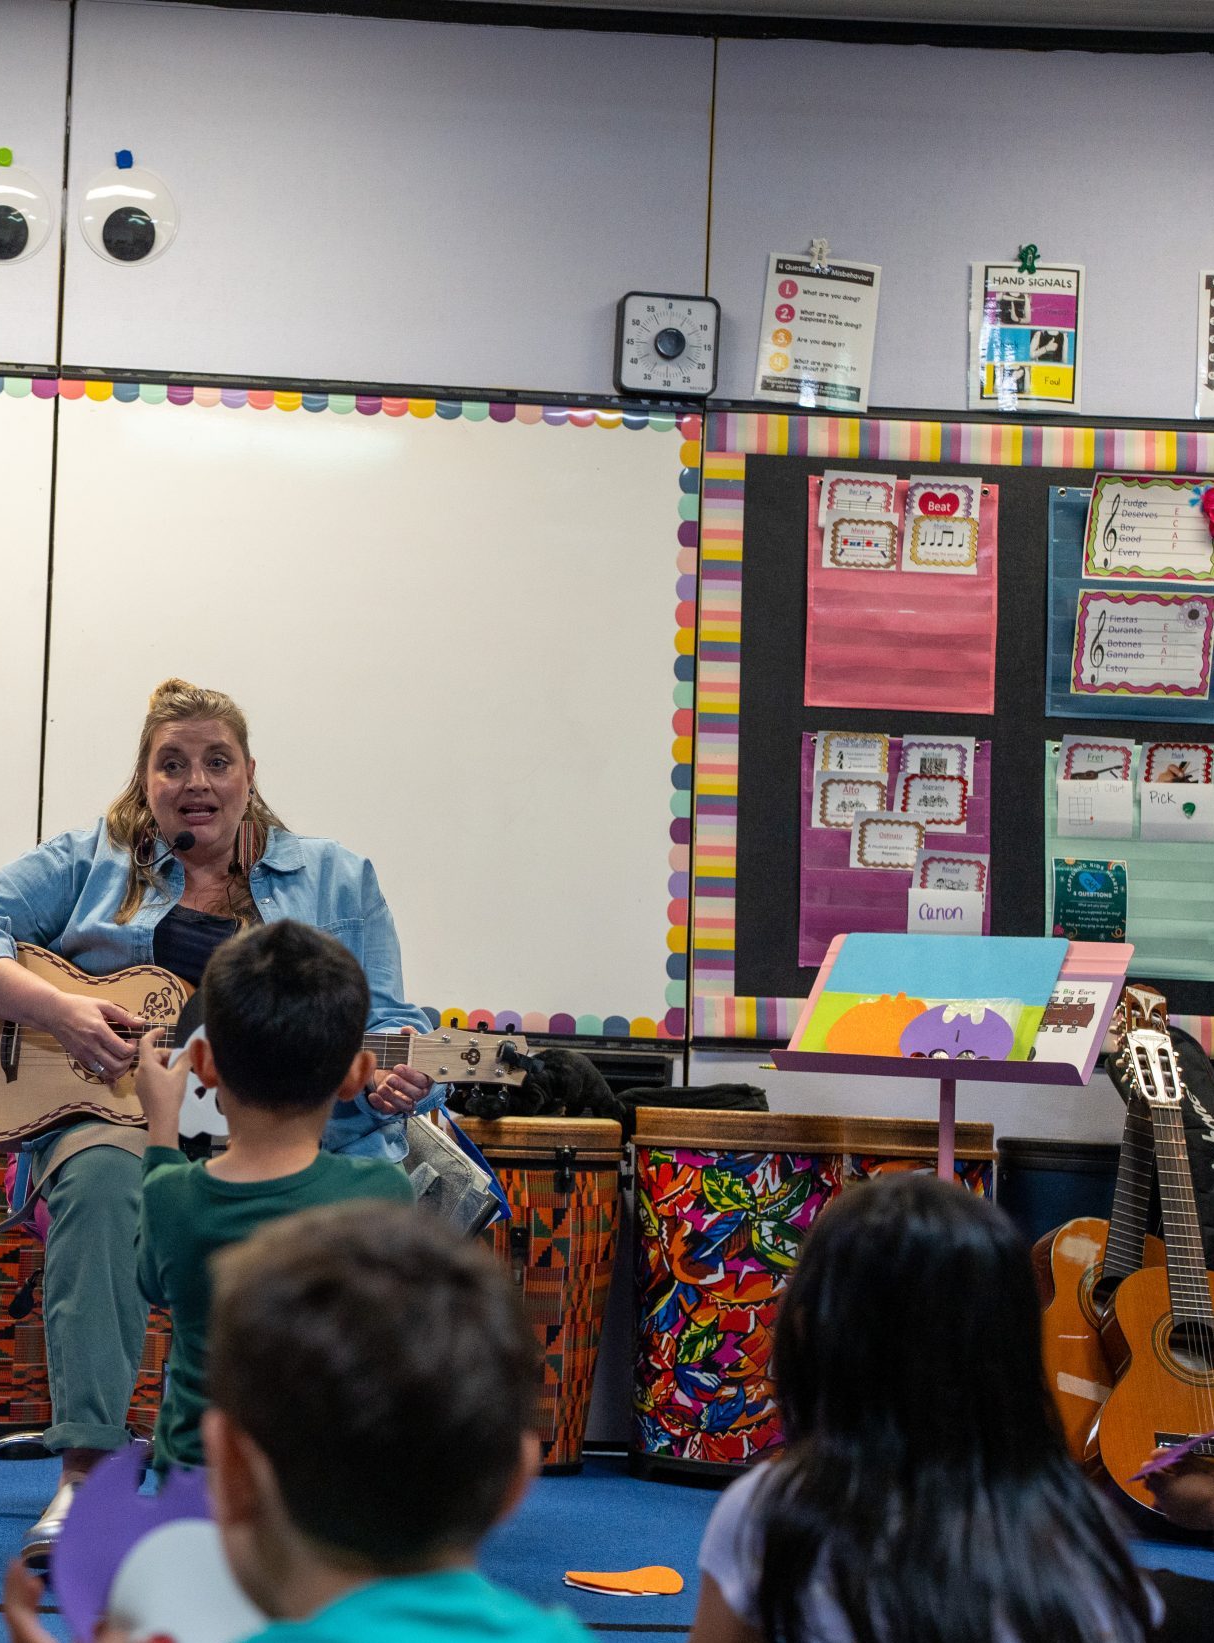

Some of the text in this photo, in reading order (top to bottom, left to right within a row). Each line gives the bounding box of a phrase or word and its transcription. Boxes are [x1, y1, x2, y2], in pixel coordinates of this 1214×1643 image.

[993, 276, 1073, 289] HAND SIGNALS
[802, 288, 817, 297] What
[842, 295, 861, 303] doing?
[799, 315, 827, 324] supposed
[844, 321, 862, 329] doing?
[797, 336, 808, 344] Are
[810, 337, 820, 346] you
[630, 357, 638, 365] 40
[643, 373, 652, 381] 35
[682, 376, 691, 384] 25
[1044, 377, 1061, 386] Foul
[928, 500, 951, 512] Beat
[1123, 498, 1148, 508] Fudge
[1121, 509, 1158, 519] Deserves
[850, 527, 875, 535] Measure
[1120, 523, 1136, 533] Boy
[1119, 535, 1142, 543] Good
[1172, 532, 1178, 540] A
[1118, 547, 1141, 557] Every
[1109, 614, 1138, 623] Fiestas
[1108, 625, 1143, 634] Durante
[1107, 639, 1142, 648] Botones
[1106, 650, 1145, 659] Ganando
[1105, 664, 1129, 674] Estoy
[1087, 752, 1104, 761] Fret
[842, 785, 860, 794] Alto
[1073, 782, 1125, 794] Chord Chart
[1149, 790, 1177, 805] Pick
[1078, 891, 1113, 899] QUESTIONS
[918, 902, 964, 921] Canon
[1063, 988, 1075, 996] Big
[1078, 988, 1097, 996] Ears
